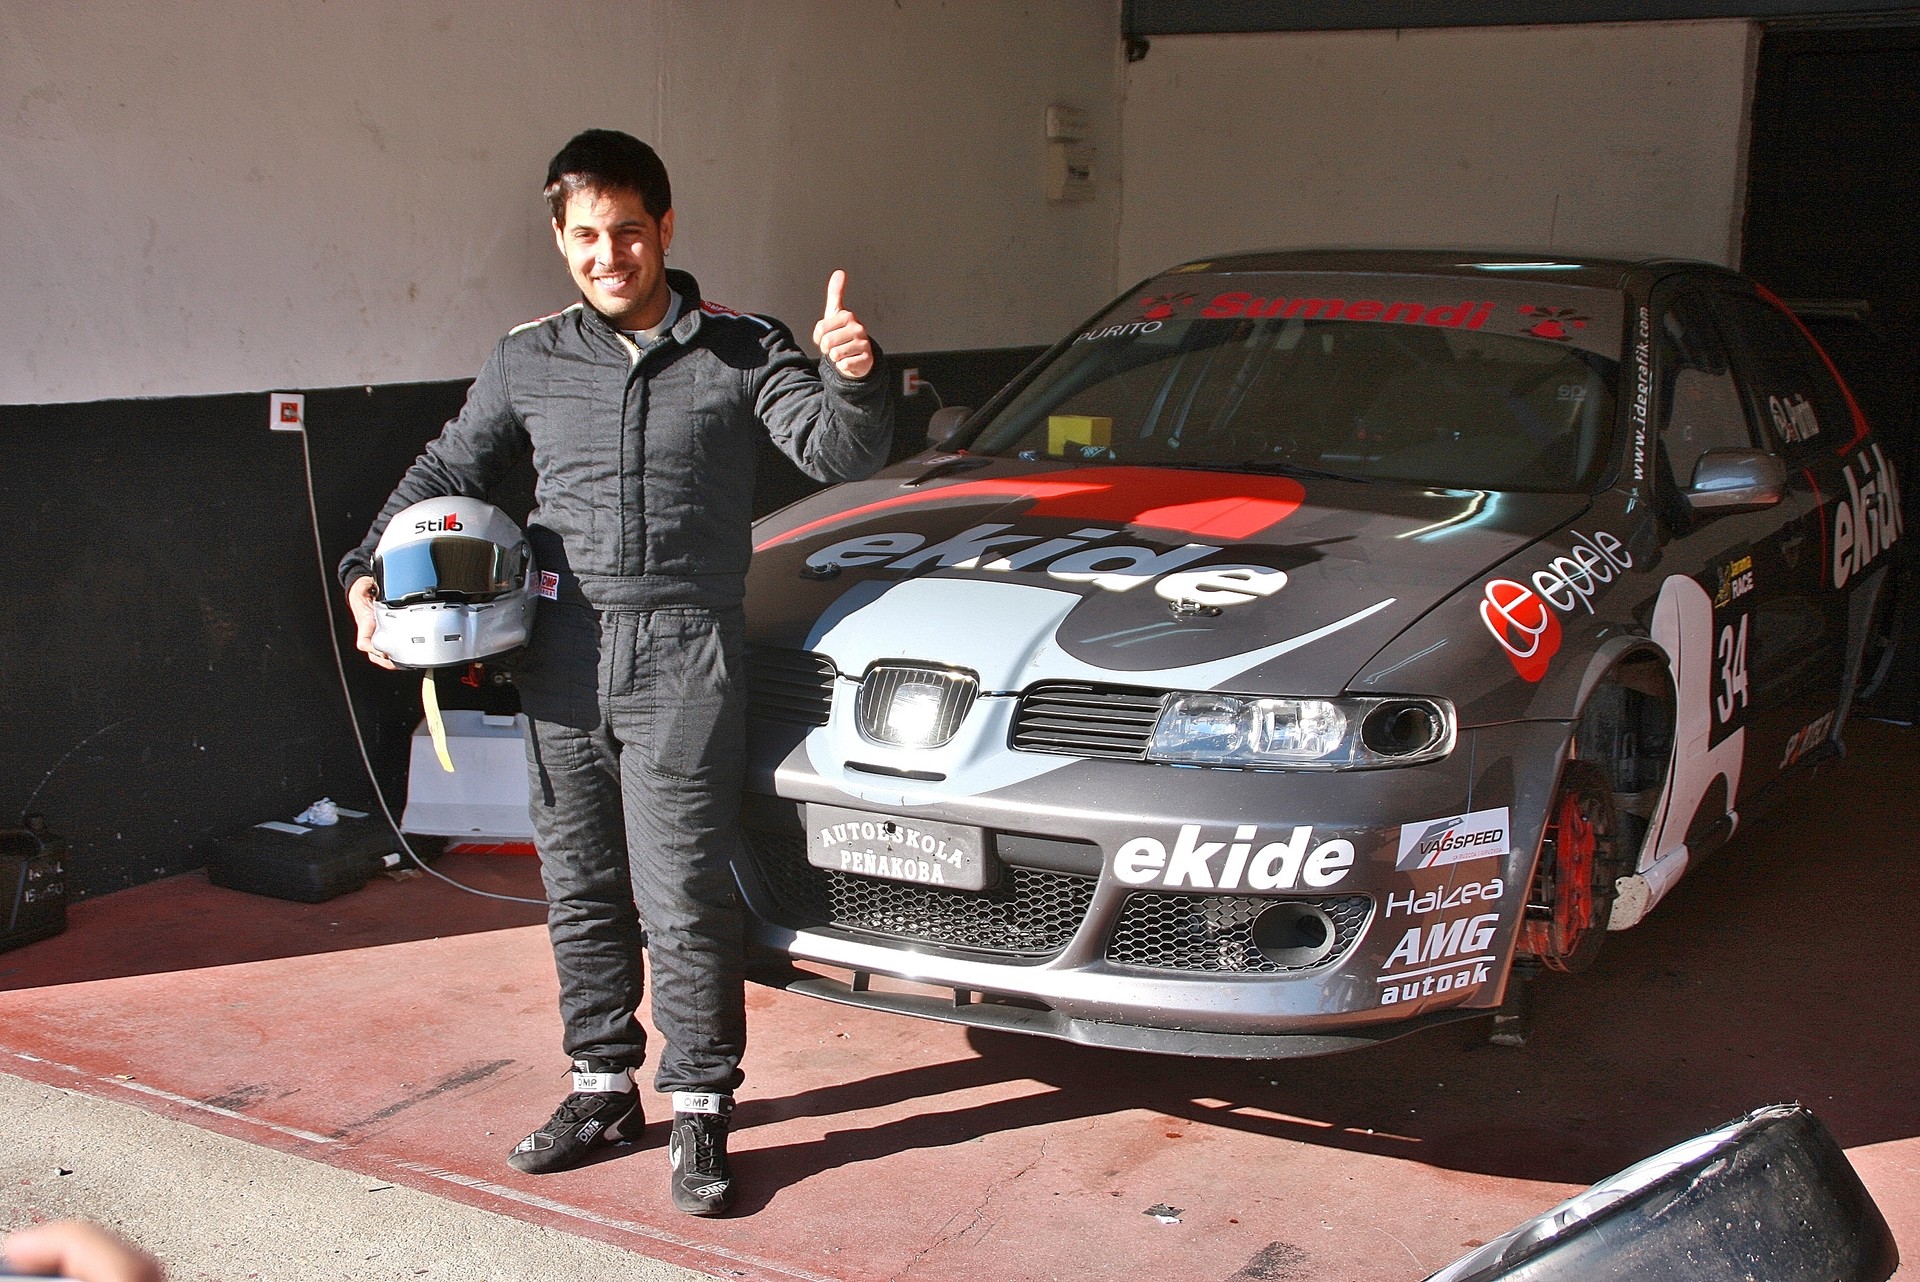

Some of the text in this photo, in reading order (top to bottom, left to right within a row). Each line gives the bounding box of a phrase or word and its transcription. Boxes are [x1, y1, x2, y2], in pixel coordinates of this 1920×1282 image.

[1202, 291, 1496, 330] Sumendi
[1072, 321, 1162, 346] PURITO
[806, 524, 1288, 605] ekide
[1532, 530, 1633, 615] epele
[1717, 613, 1749, 723] 34
[821, 821, 964, 869] AUTOESKOLA
[1113, 824, 1355, 890] ekide
[1420, 829, 1504, 855] VAGSPEED
[840, 849, 945, 883] PEÑAKOBA
[1385, 878, 1504, 918] Haizea
[1382, 913, 1500, 969] AMG
[1381, 962, 1491, 1005] autoak
[577, 1078, 598, 1088] OMP
[685, 1098, 709, 1108] OMP
[579, 1120, 600, 1142] OMP
[696, 1183, 727, 1196] OMP
